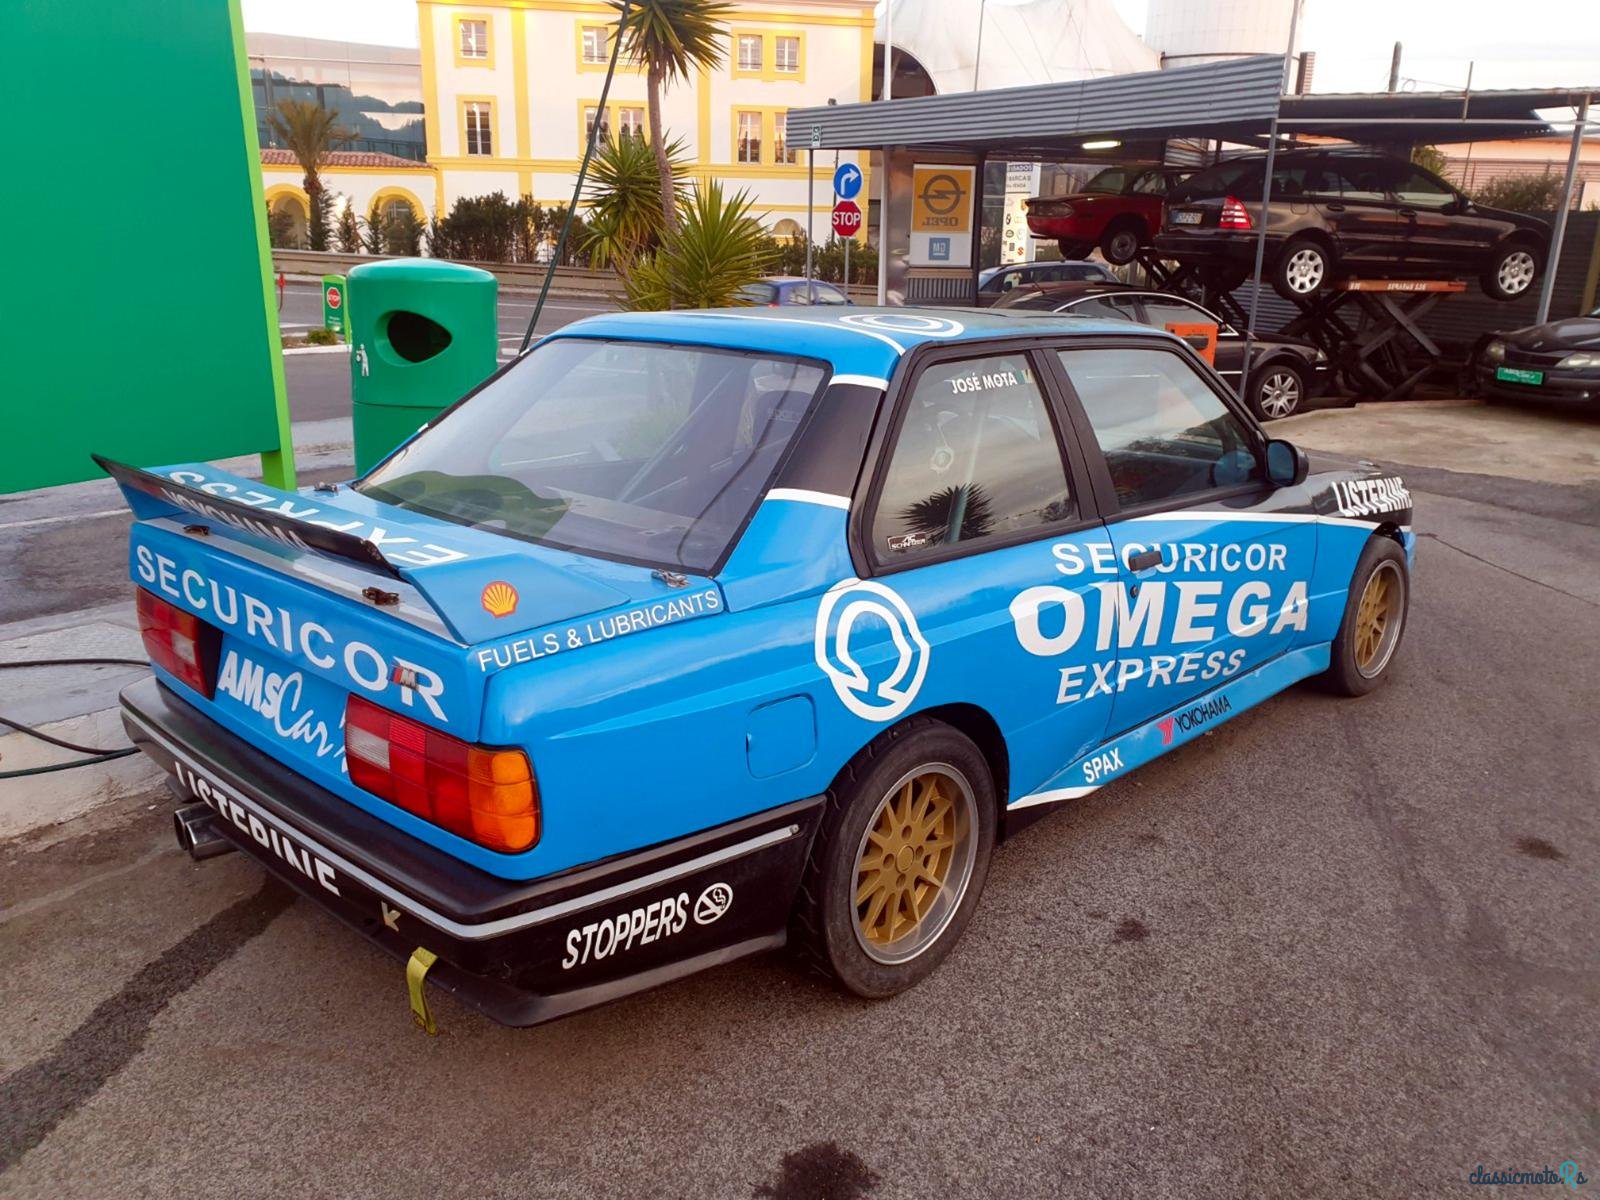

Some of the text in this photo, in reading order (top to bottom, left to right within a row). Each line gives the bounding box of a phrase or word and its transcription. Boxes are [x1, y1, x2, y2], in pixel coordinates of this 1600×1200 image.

[832, 210, 861, 226] STOP
[951, 371, 1018, 394] JOSÉ MOTA
[1331, 476, 1413, 517] LISTERINE
[1051, 542, 1287, 575] SECURICOR
[136, 544, 449, 723] SECURICOR
[478, 590, 719, 672] FUELS & LUBRICANTS
[1009, 581, 1309, 656] OMEGA
[1056, 648, 1246, 704] EXPRESS
[1175, 695, 1232, 733] YOKOHAMA
[1083, 748, 1124, 783] SPAX
[562, 892, 690, 970] STOPPERS
